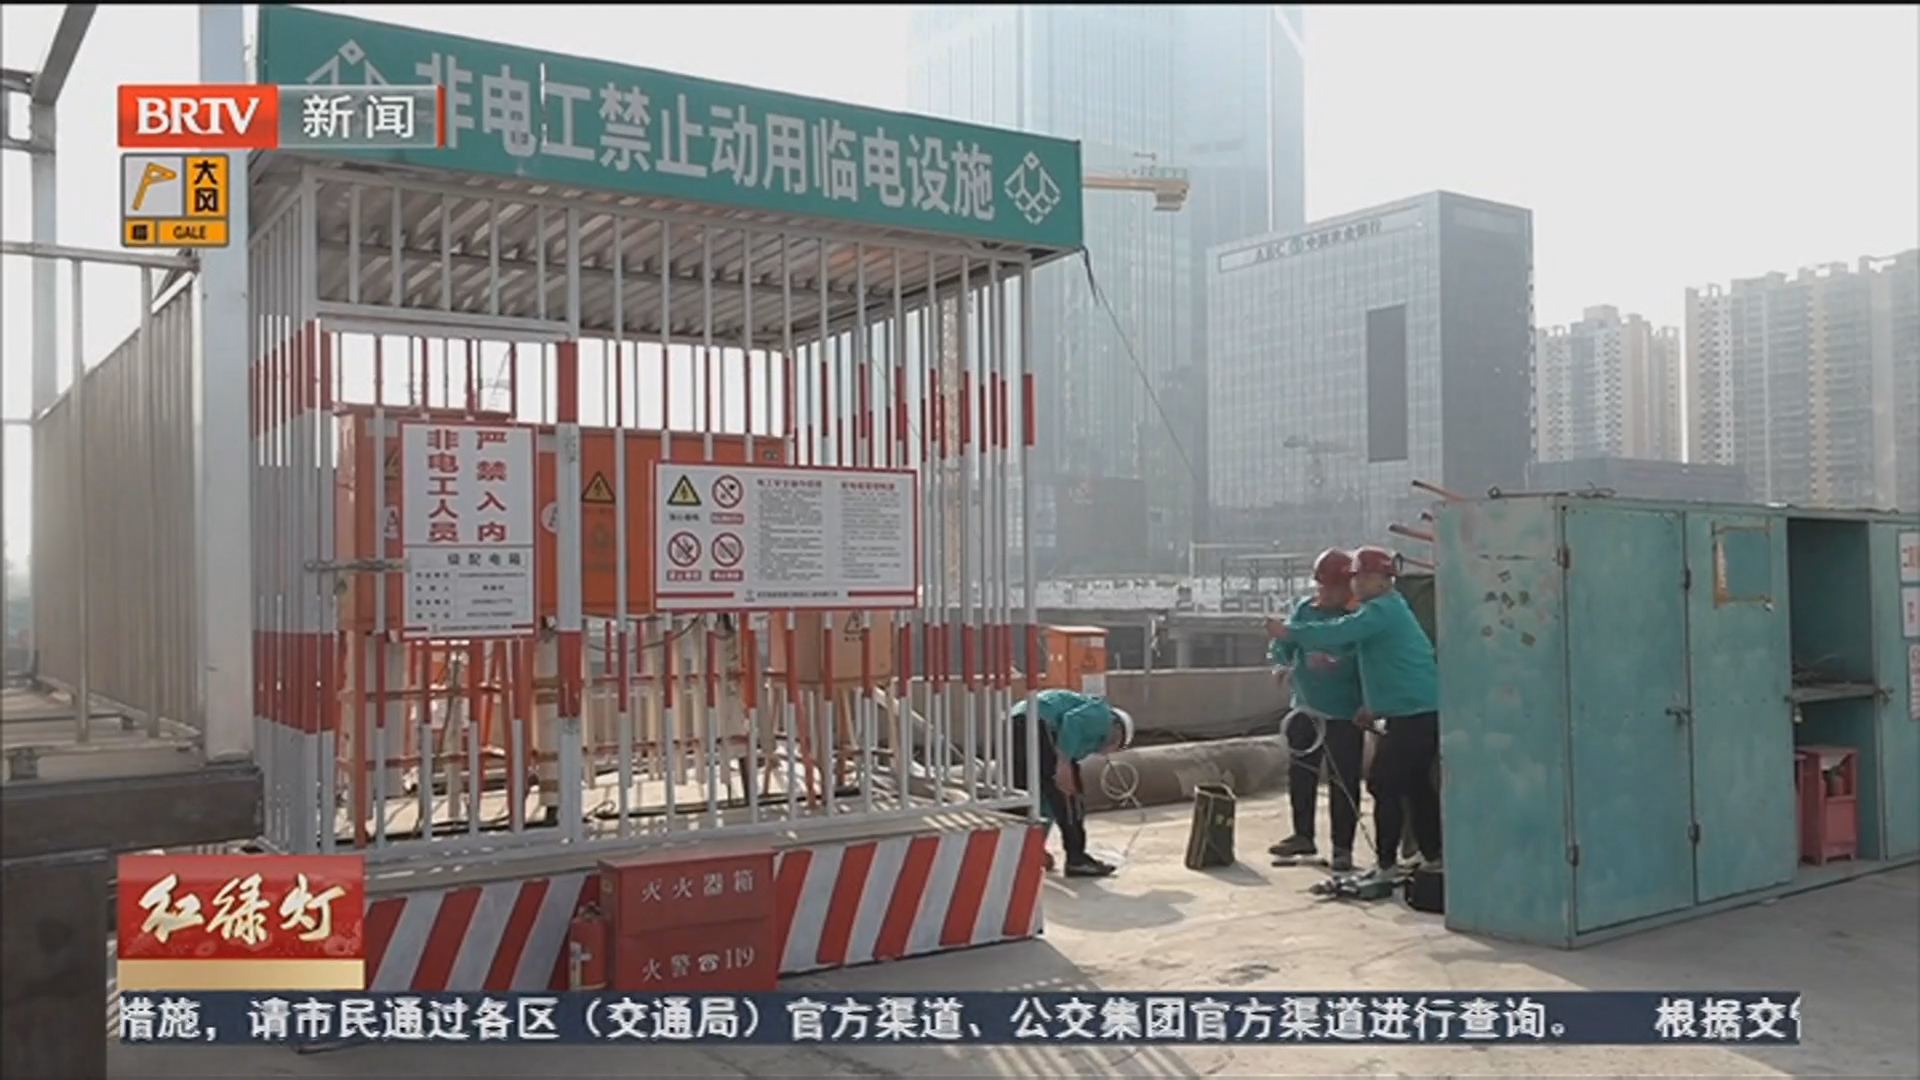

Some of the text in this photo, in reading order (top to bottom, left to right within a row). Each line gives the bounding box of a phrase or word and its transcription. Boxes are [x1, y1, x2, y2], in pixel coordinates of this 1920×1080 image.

[415, 53, 996, 221] 非电工禁止动用临电设施
[427, 429, 459, 542] 非电工人员
[476, 431, 507, 542] 严禁入内
